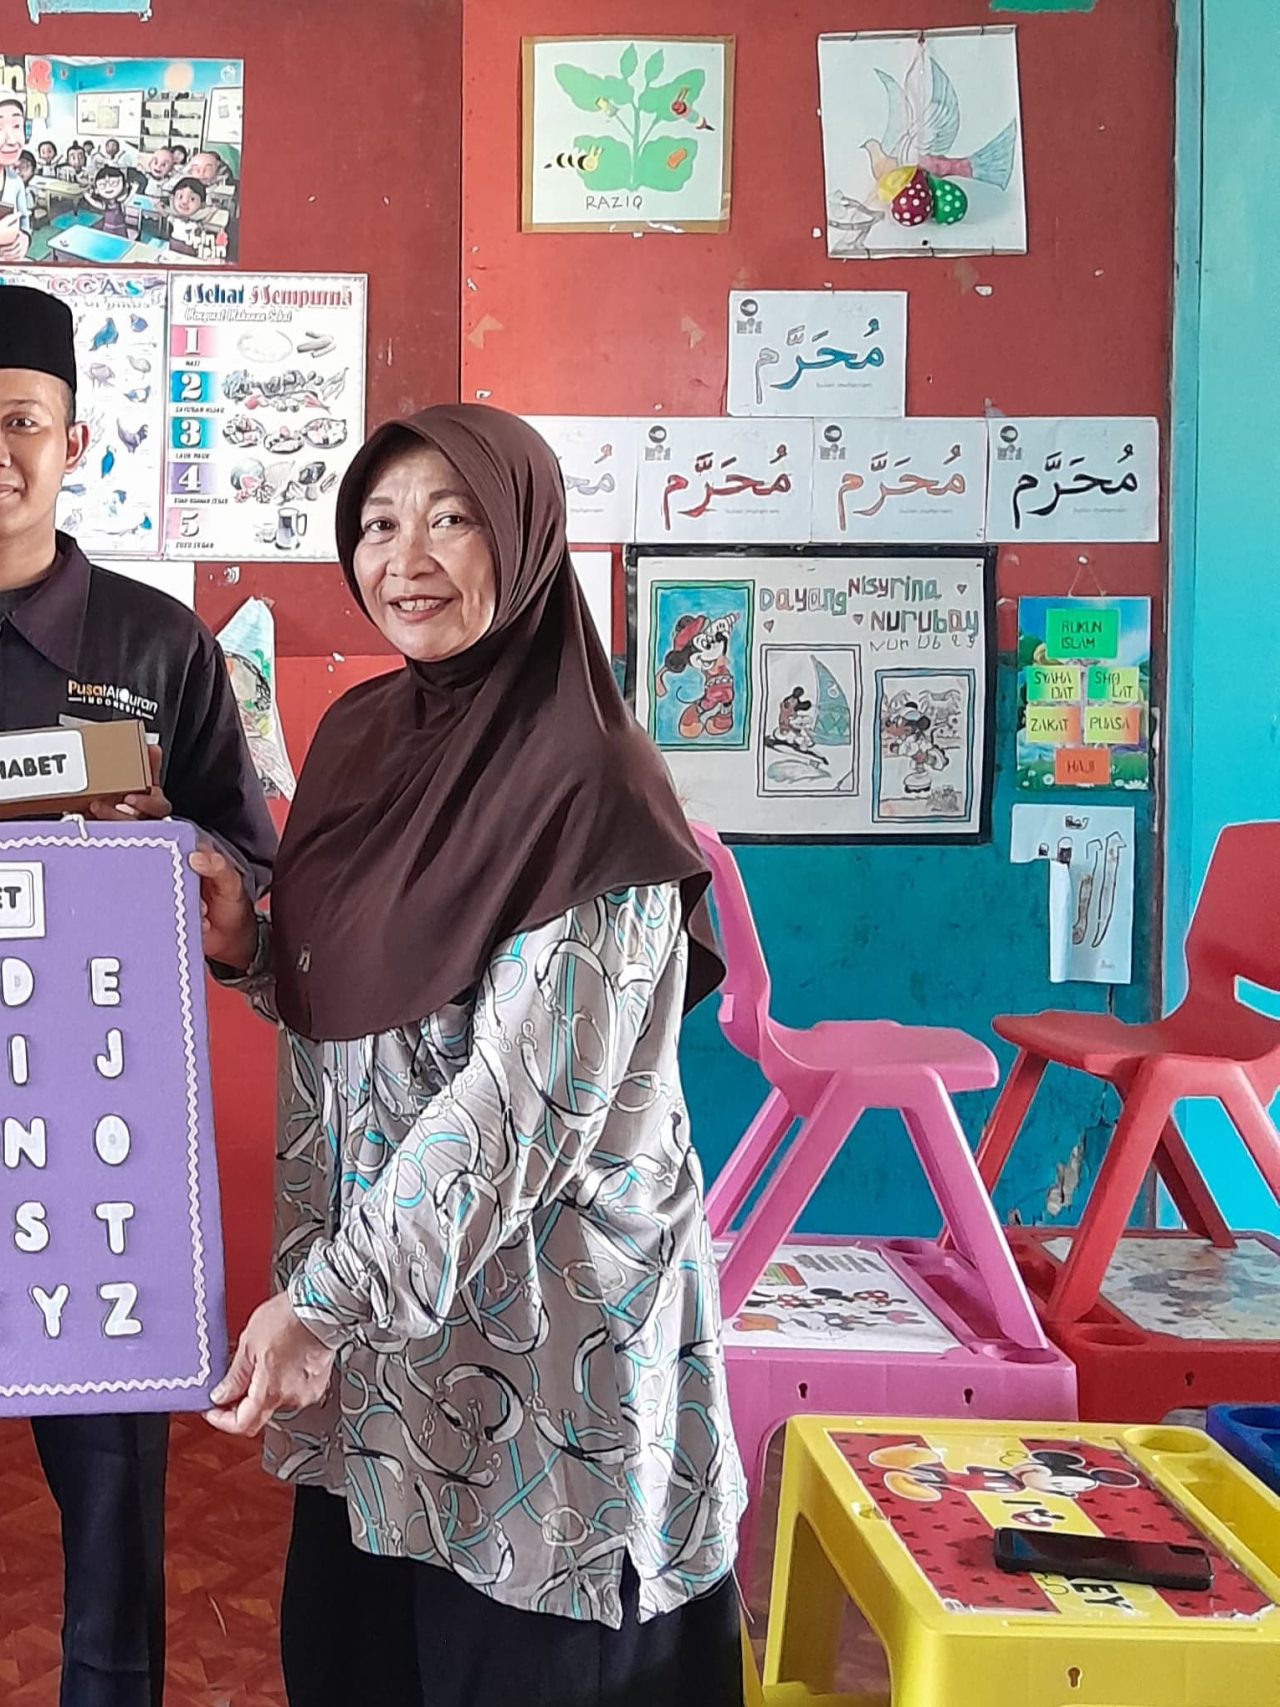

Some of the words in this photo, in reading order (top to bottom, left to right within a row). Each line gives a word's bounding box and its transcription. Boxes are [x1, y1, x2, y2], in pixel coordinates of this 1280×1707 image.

[585, 194, 643, 211] RAZIQ
[48, 273, 144, 297] GGAS
[194, 283, 245, 304] Sehat
[261, 284, 353, 308] Sempurna
[184, 327, 201, 356] 1
[180, 372, 203, 402] 2
[179, 418, 202, 448] 3
[178, 462, 201, 493] 4
[180, 511, 200, 537] 5
[759, 588, 847, 616] Dayang
[1061, 621, 1102, 634] RUKUN
[1061, 637, 1096, 650] ISLAM
[1034, 671, 1072, 685] SYAHA
[1051, 686, 1074, 699] DAT
[1112, 685, 1133, 698] LAT
[83, 696, 142, 717] INDONESIA
[1031, 718, 1069, 732] ZAKAT
[1089, 716, 1130, 731] PUASA
[1, 957, 34, 1006] D
[89, 957, 120, 1005] E
[8, 1035, 28, 1084] I
[96, 1029, 123, 1078] J
[4, 1117, 46, 1168] N
[95, 1115, 130, 1165] O
[14, 1201, 49, 1252] S
[95, 1202, 134, 1254] T
[31, 1284, 69, 1337] Y
[99, 1282, 142, 1336] Z
